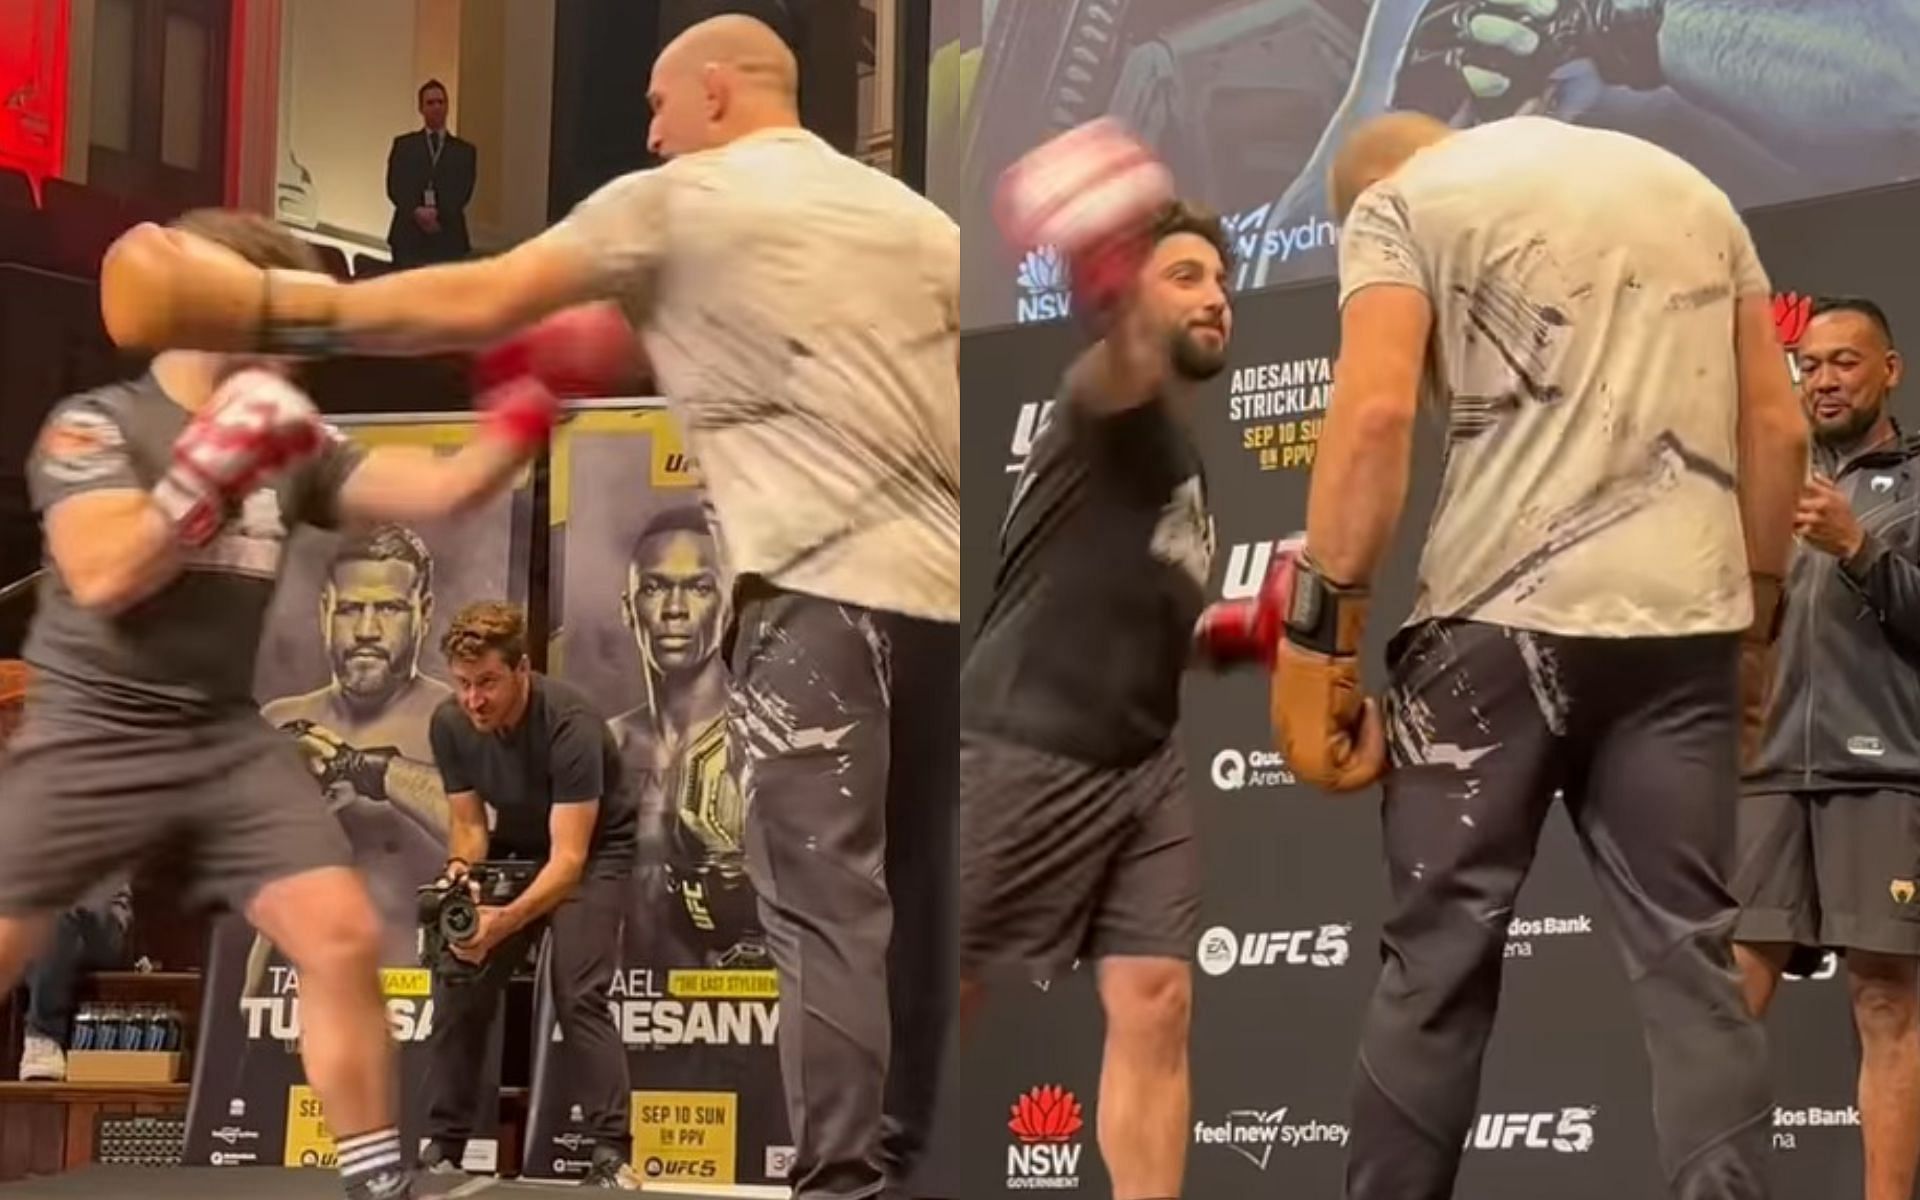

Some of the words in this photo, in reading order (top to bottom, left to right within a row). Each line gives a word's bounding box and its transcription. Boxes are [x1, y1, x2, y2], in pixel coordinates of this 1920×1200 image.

[1264, 215, 1339, 262] sydn
[1230, 357, 1331, 395] ADESANYA
[1243, 425, 1275, 449] SEP
[1279, 421, 1296, 444] 10
[1282, 442, 1316, 467] PPV
[1248, 770, 1297, 787] Arena
[641, 1105, 671, 1123] SEP
[675, 1106, 691, 1124] 10
[695, 1106, 726, 1125] SUN
[679, 1129, 705, 1146] PPV
[1194, 1120, 1232, 1143] feel
[1234, 1125, 1279, 1142] new
[1280, 1119, 1350, 1147] sydney
[1007, 1143, 1082, 1176] NSW
[1006, 1176, 1080, 1190] GOVERNMENT
